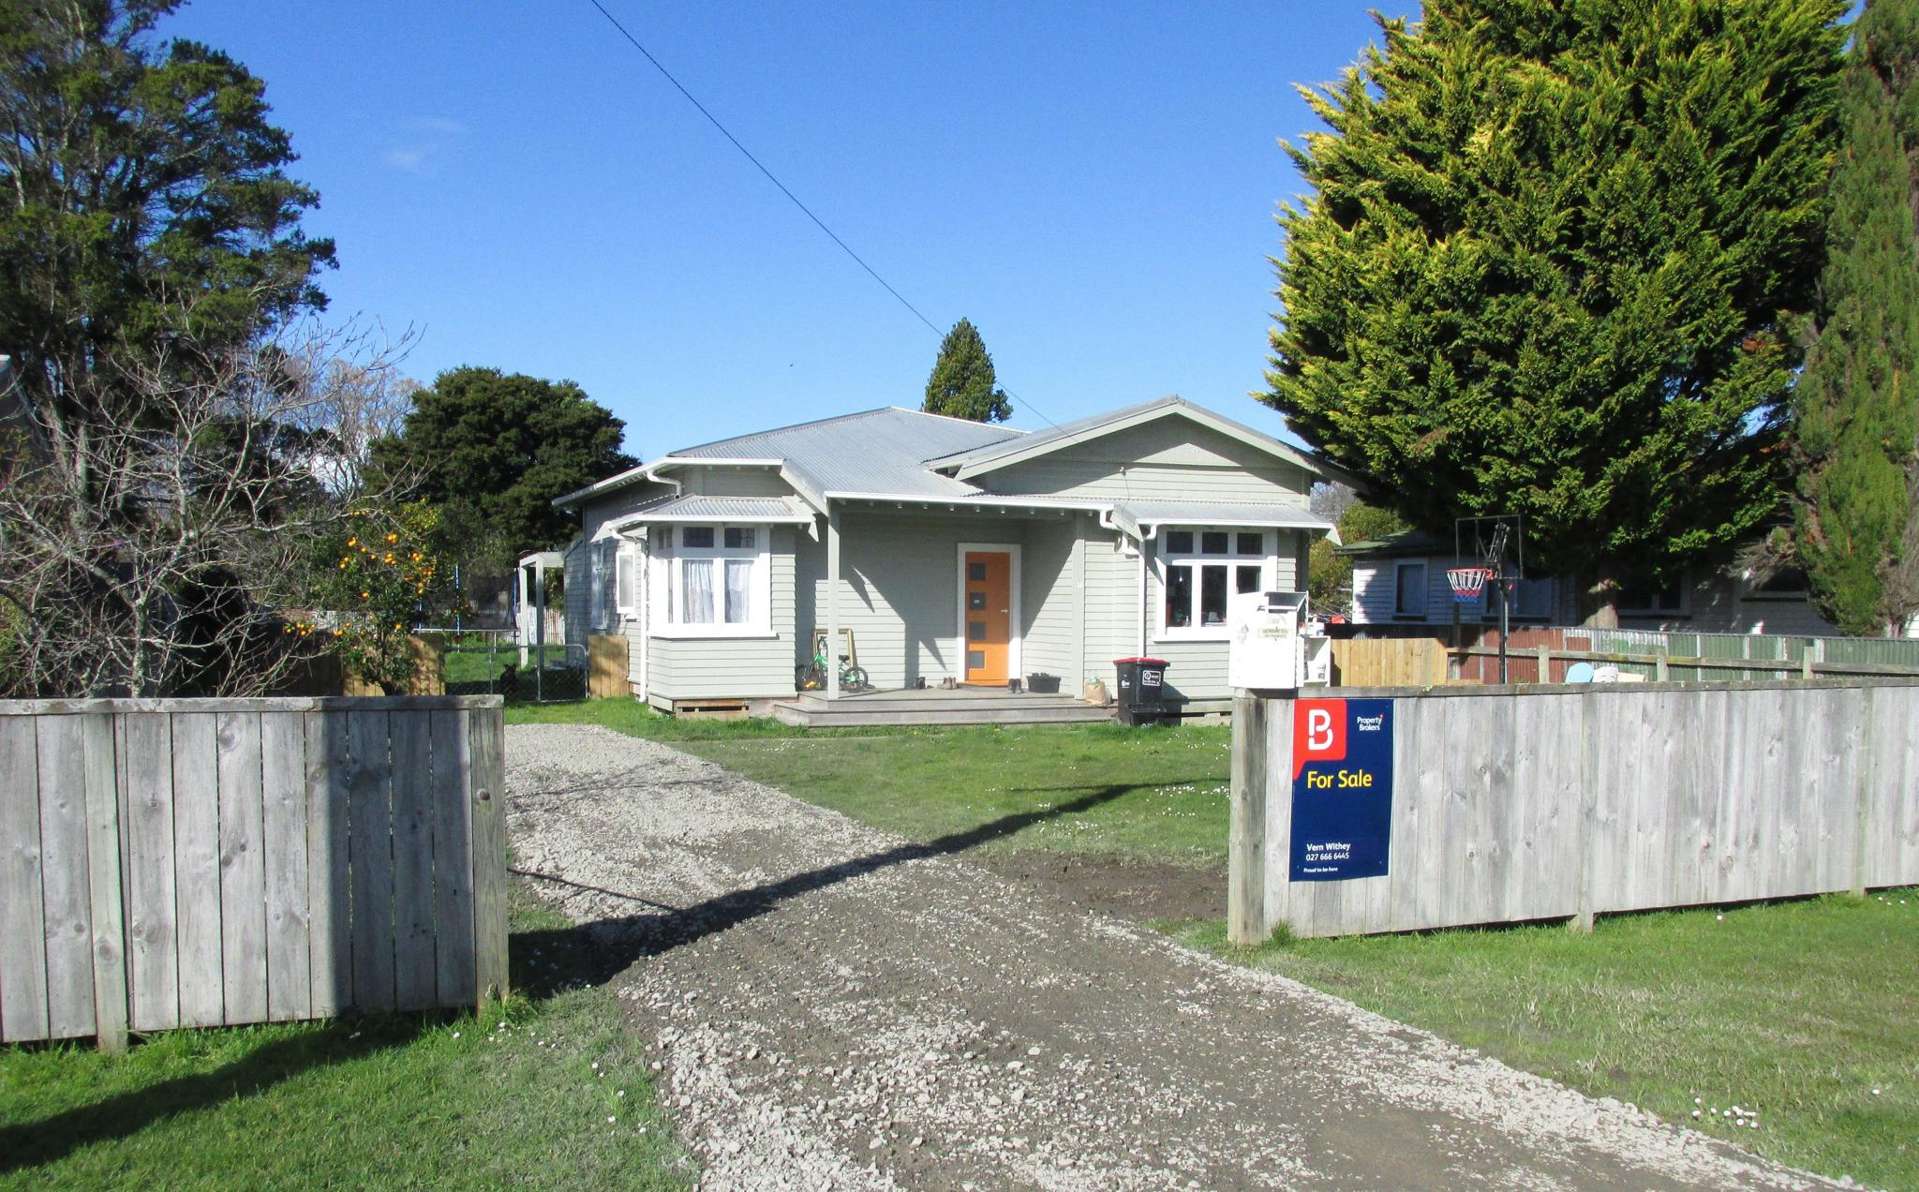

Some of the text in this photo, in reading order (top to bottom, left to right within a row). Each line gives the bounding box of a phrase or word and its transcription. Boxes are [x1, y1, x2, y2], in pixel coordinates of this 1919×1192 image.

[1356, 714, 1382, 725] Property
[1359, 723, 1380, 731] Brokers
[1307, 769, 1373, 789] For Sale
[1306, 842, 1351, 851] Vern Withey
[1305, 853, 1319, 861] 027
[1320, 853, 1333, 861] 666
